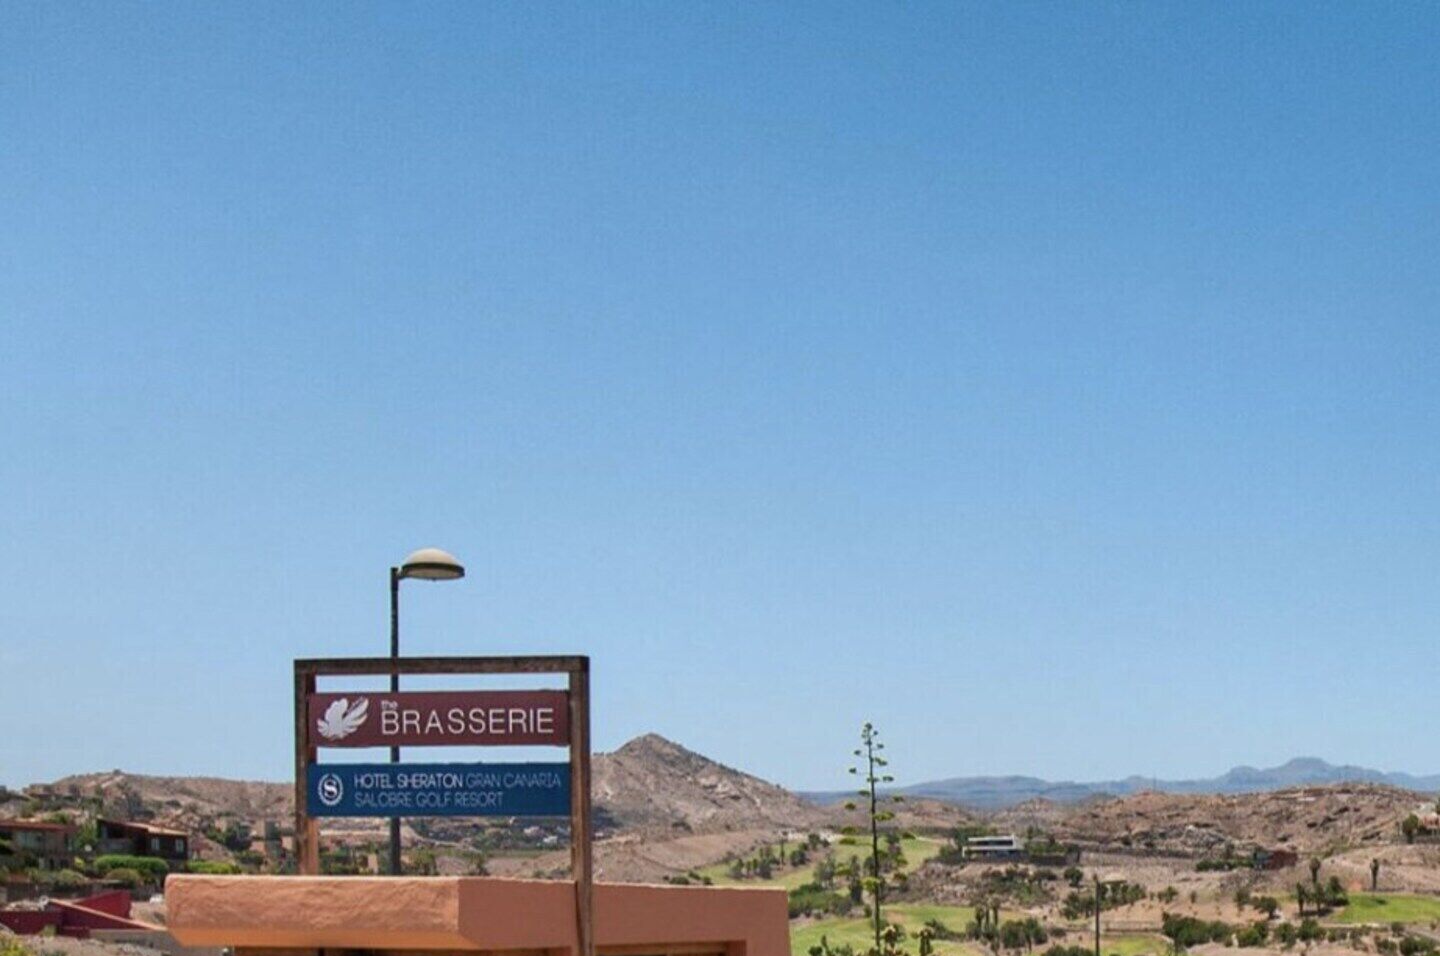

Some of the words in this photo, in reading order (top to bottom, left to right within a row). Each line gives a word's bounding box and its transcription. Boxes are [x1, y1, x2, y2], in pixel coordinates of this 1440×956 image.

[381, 708, 555, 736] BRASSERIE
[354, 773, 393, 789] HOTEL
[397, 773, 463, 789] SHERATON
[465, 773, 501, 788] GRAN
[503, 772, 562, 788] CANARIA
[354, 792, 412, 808] SALOBRE
[416, 791, 449, 808] GOLF
[454, 791, 504, 807] RESORT
